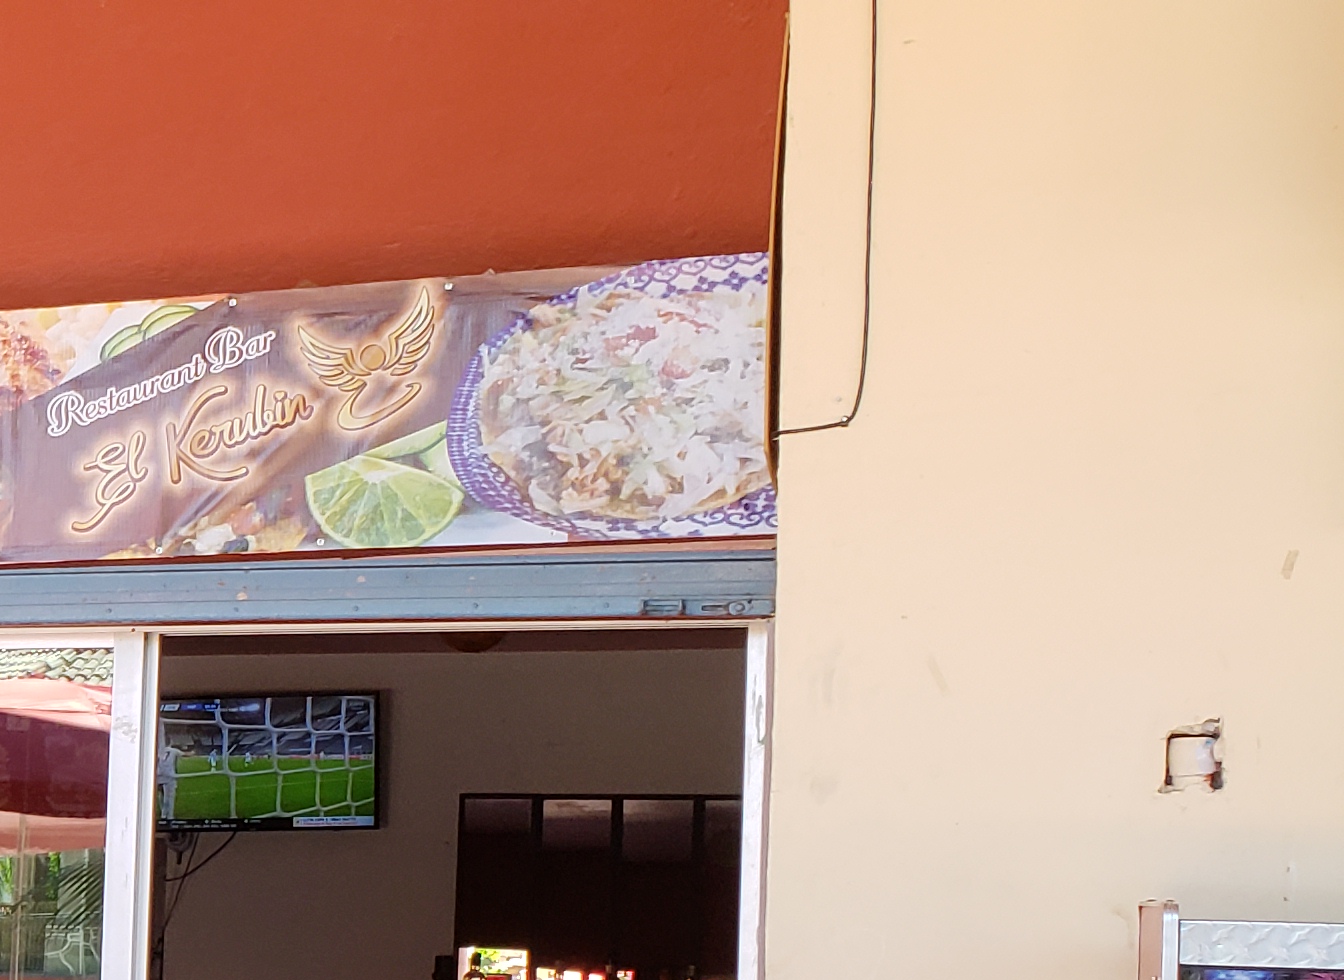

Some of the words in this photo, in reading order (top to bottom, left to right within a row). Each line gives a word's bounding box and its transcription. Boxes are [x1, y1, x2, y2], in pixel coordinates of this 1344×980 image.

[47, 354, 207, 438] Restaurant
[205, 324, 277, 374] Bar
[71, 430, 148, 533] El
[165, 384, 314, 485] Kerubin
